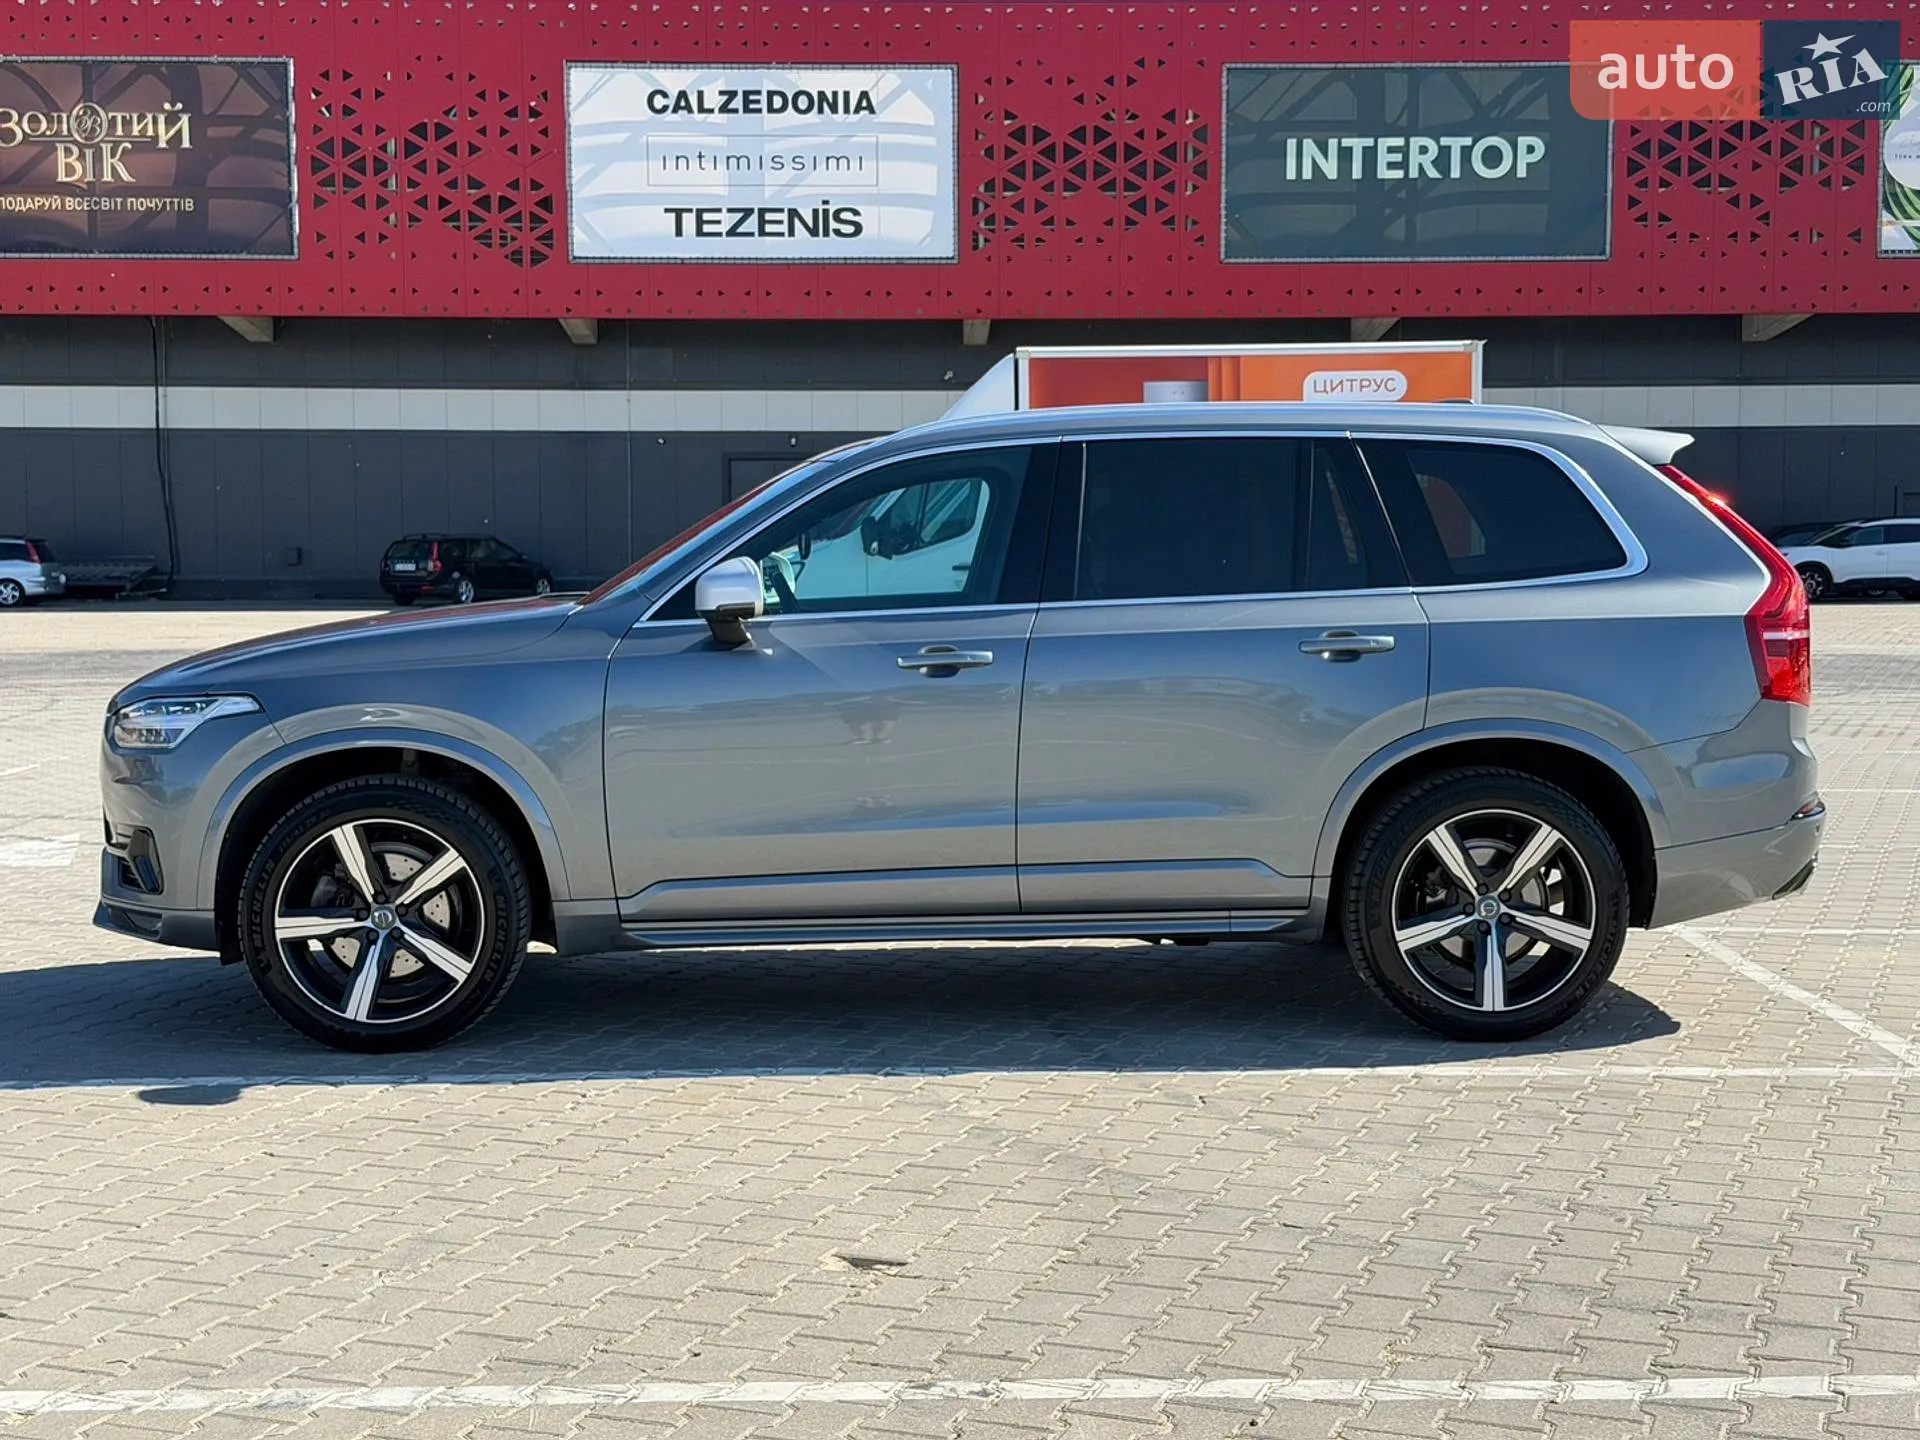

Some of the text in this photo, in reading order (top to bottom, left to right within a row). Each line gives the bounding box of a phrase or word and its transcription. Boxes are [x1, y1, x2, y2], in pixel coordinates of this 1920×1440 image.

[646, 89, 876, 115] CALZEDONIA
[56, 143, 136, 188] ВІК
[661, 151, 864, 172] intimissimi
[1285, 135, 1547, 181] INTERTOP
[65, 197, 123, 212] ВСЕСВІТ
[127, 197, 195, 213] ПОЧУТТІВ
[1313, 377, 1397, 395] ЦИТРУС
[251, 857, 276, 951] MICHELIN
[484, 894, 510, 983] MICHELIN
